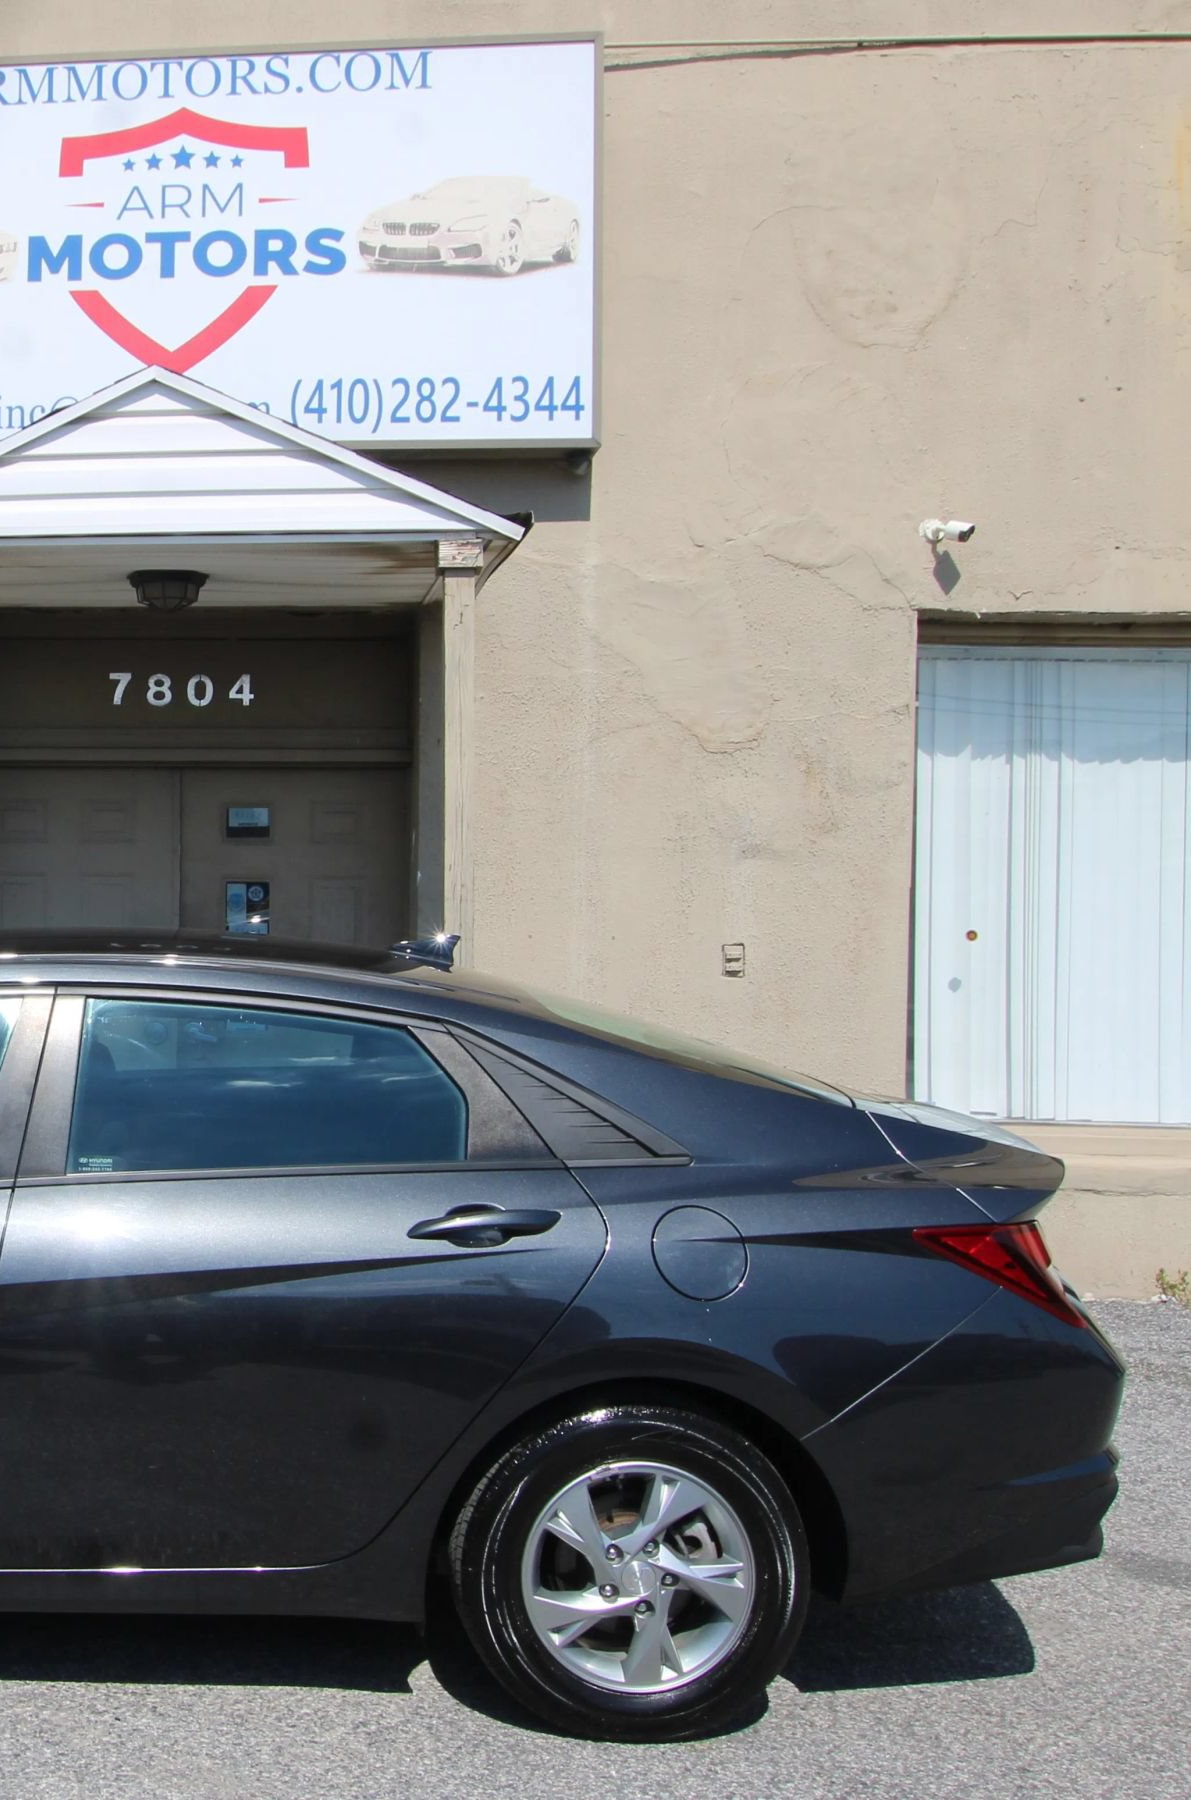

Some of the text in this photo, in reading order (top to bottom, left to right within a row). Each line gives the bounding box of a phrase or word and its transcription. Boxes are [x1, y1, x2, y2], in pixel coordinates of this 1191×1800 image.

[116, 182, 245, 221] ARM
[27, 227, 347, 283] MOTORS
[291, 375, 585, 434] (410)282-4344
[109, 672, 255, 707] 7804
